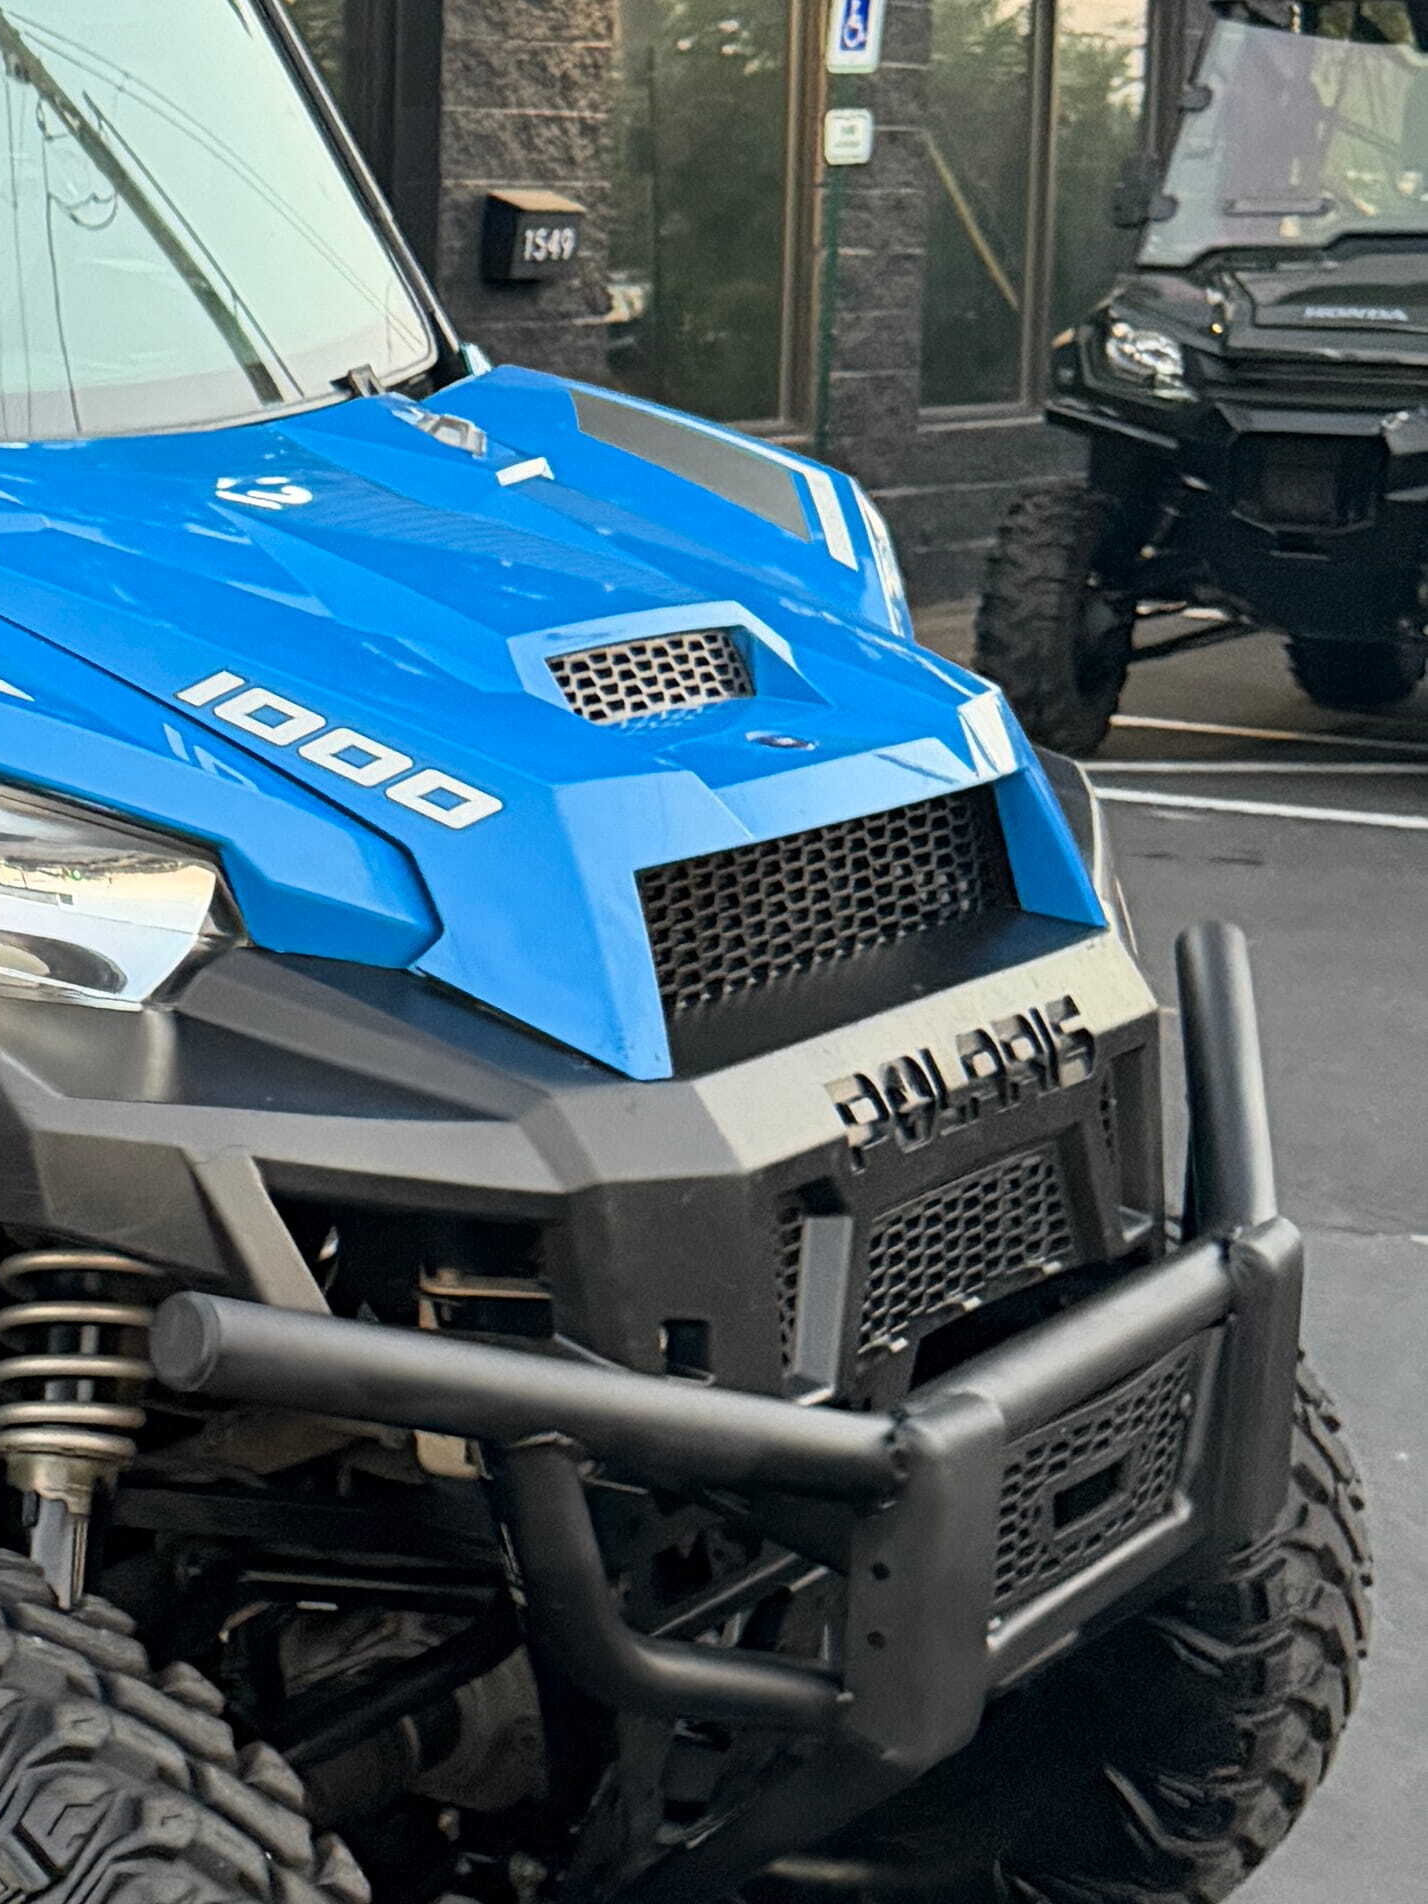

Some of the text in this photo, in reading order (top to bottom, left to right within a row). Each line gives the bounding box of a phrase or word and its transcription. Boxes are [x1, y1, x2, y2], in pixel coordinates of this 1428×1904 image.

[524, 227, 575, 262] 1549
[175, 670, 503, 830] 1000
[824, 994, 1096, 1176] POLARIS
